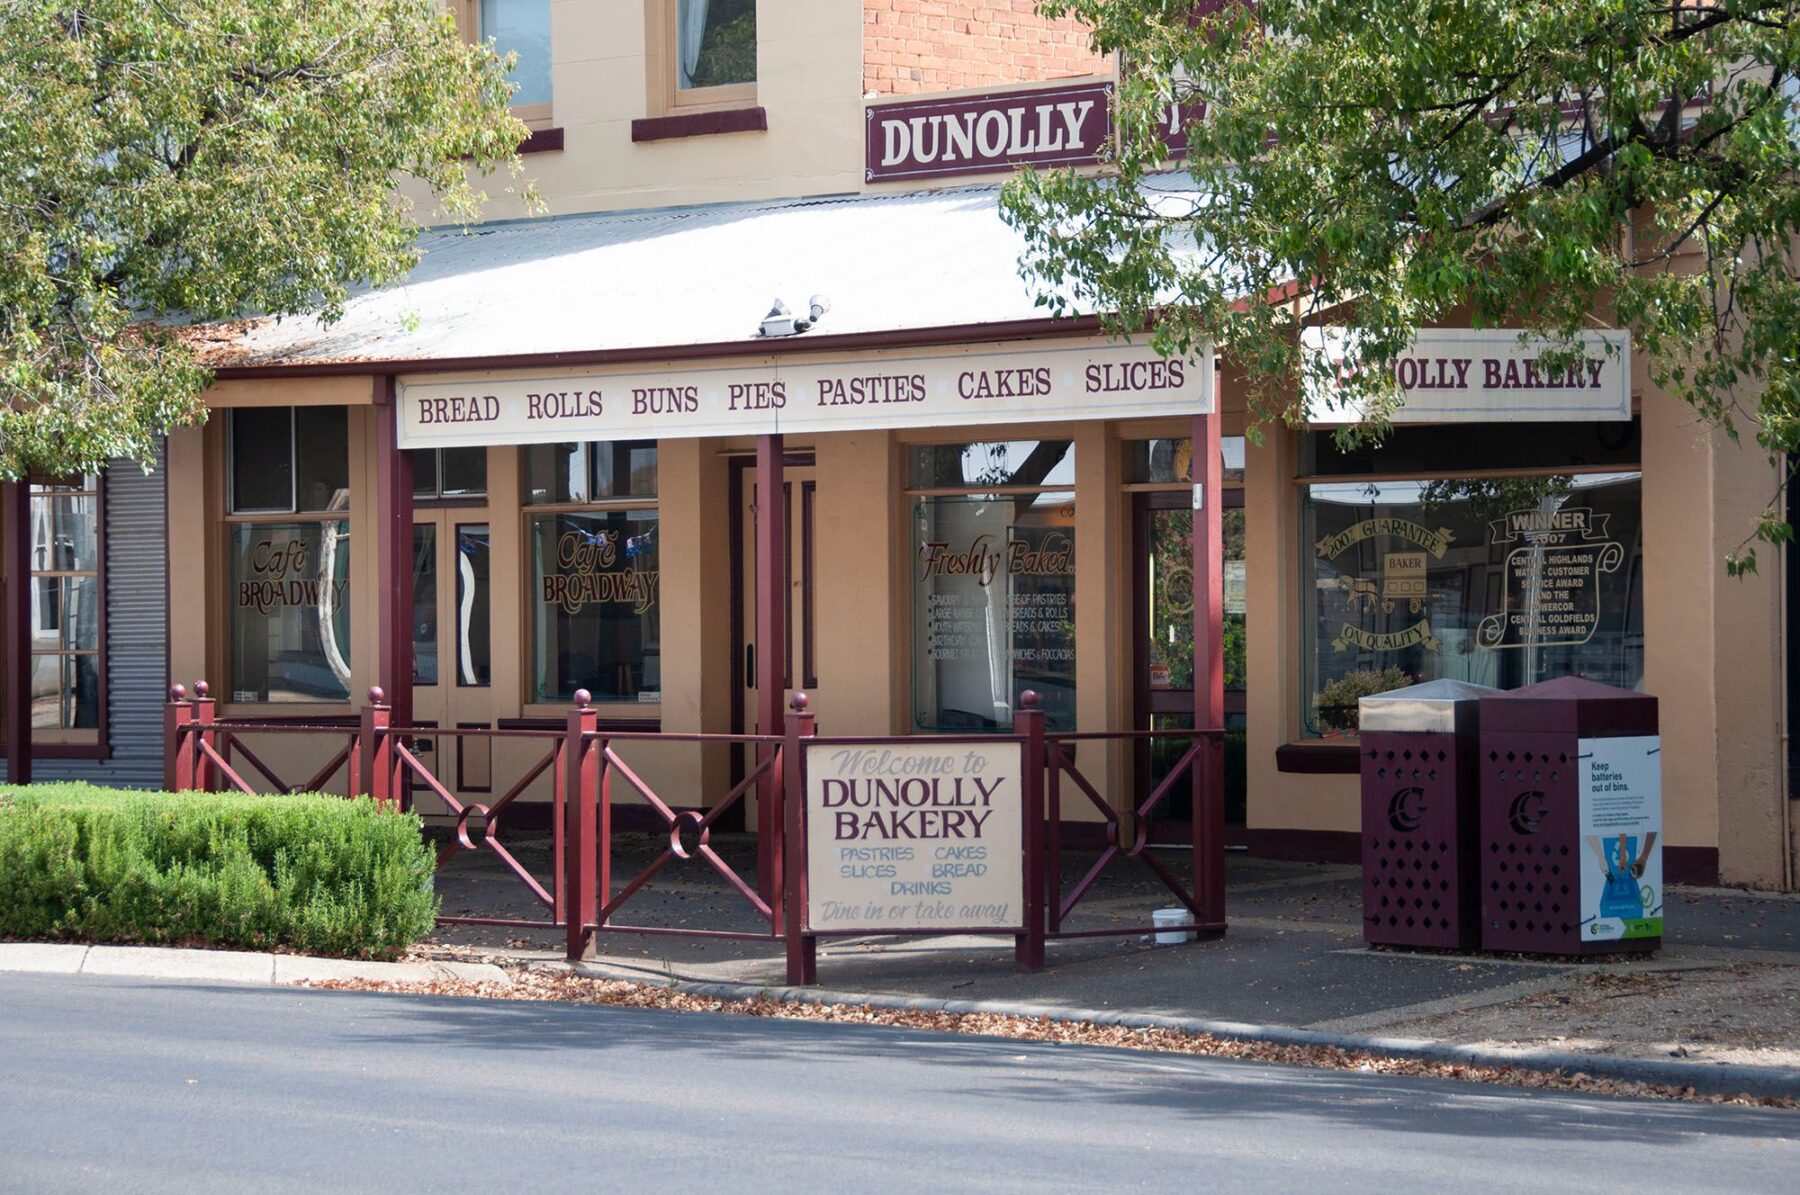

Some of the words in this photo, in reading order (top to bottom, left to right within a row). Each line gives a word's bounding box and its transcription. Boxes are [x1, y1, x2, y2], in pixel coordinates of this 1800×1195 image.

[881, 100, 1095, 167] DUNOLLY
[418, 395, 500, 424] BREAD
[526, 390, 603, 420] ROLLS
[631, 386, 699, 415] BUNS
[728, 382, 787, 411] PIES
[816, 374, 926, 406] PASTIES
[957, 367, 1052, 400] CAKES
[1085, 359, 1185, 394] SLICES
[1511, 511, 1586, 531] WINNER
[1362, 519, 1440, 553] GUARANTEE
[1530, 533, 1567, 545] 2007
[557, 529, 619, 576] Café
[253, 540, 308, 580] Café
[918, 534, 1001, 587] Freshly
[1389, 557, 1422, 569] BAKER
[1511, 556, 1547, 566] CENTRAL
[1549, 554, 1593, 565] HIGHLANDS
[1548, 566, 1590, 576] CUSTOMER
[1555, 578, 1584, 588] AWARD
[239, 580, 350, 616] BROADWY
[543, 567, 660, 615] BROADWAY
[1554, 590, 1569, 600] THE
[1033, 593, 1067, 606] PASTRIES
[1532, 602, 1574, 611] OWERCOR
[1548, 613, 1596, 624] GOLDFIELDS
[1344, 626, 1361, 644] ON
[1367, 623, 1425, 650] QUALITY
[1519, 626, 1557, 636] BUNESS
[1558, 625, 1587, 635] AWARD
[830, 750, 954, 775] Welcome
[963, 750, 988, 774] to
[1591, 761, 1609, 772] Keep
[1591, 771, 1623, 782] batteries
[822, 777, 1006, 808] DUNOLLY
[1591, 783, 1603, 793] out
[1604, 782, 1611, 792] of
[1612, 781, 1630, 791] bins.
[834, 810, 993, 840] BAKERY
[840, 847, 915, 861] PASTRIES
[934, 846, 987, 860] CAKES
[840, 865, 897, 878] SLICES
[932, 864, 987, 878] BREAD
[890, 881, 953, 895] DRINKS
[822, 901, 861, 922] Dine
[864, 901, 883, 919] in
[888, 905, 910, 920] or
[914, 900, 955, 920] take
[959, 902, 1009, 924] away
